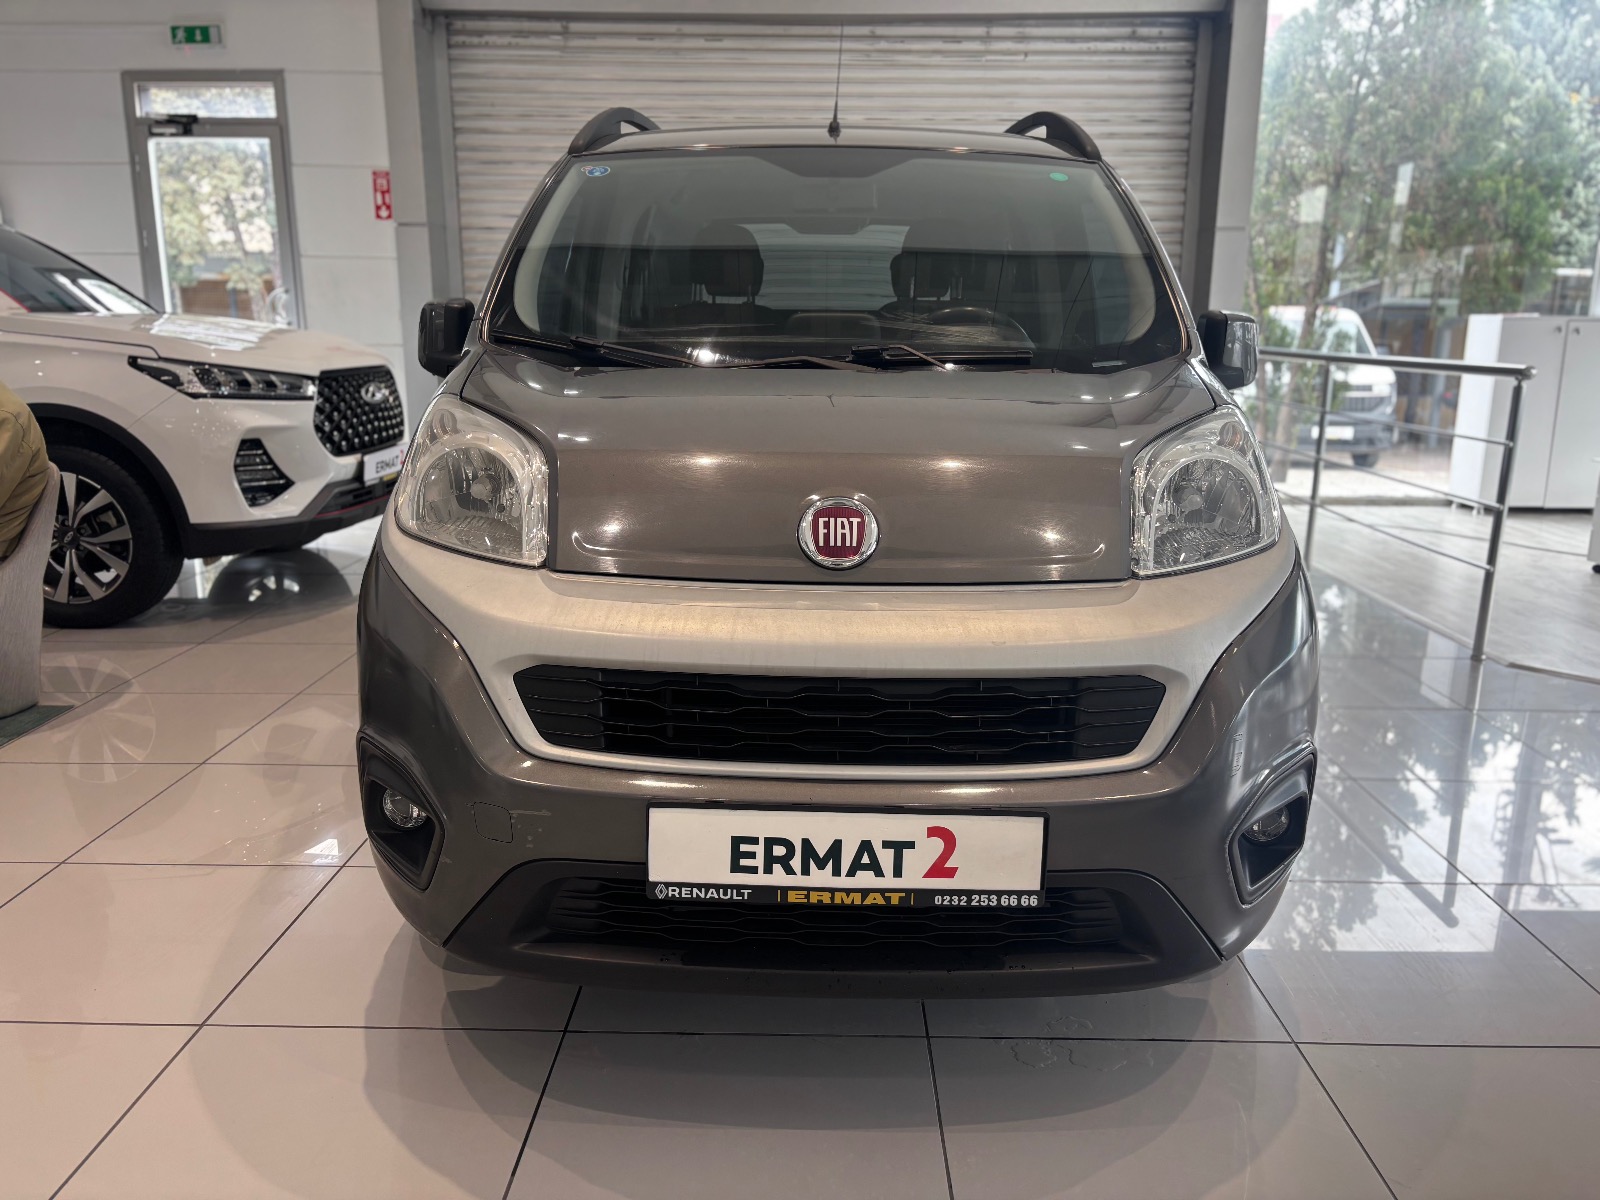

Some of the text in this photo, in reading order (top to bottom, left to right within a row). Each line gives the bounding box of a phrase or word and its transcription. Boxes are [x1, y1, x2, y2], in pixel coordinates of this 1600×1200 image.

[375, 454, 399, 474] ERMAT
[818, 517, 862, 547] FIAT
[730, 825, 960, 879] ERMAT 2
[668, 886, 753, 900] RENAULT
[787, 890, 906, 905] ERMAT
[934, 894, 1039, 907] 0232 253 66 66
